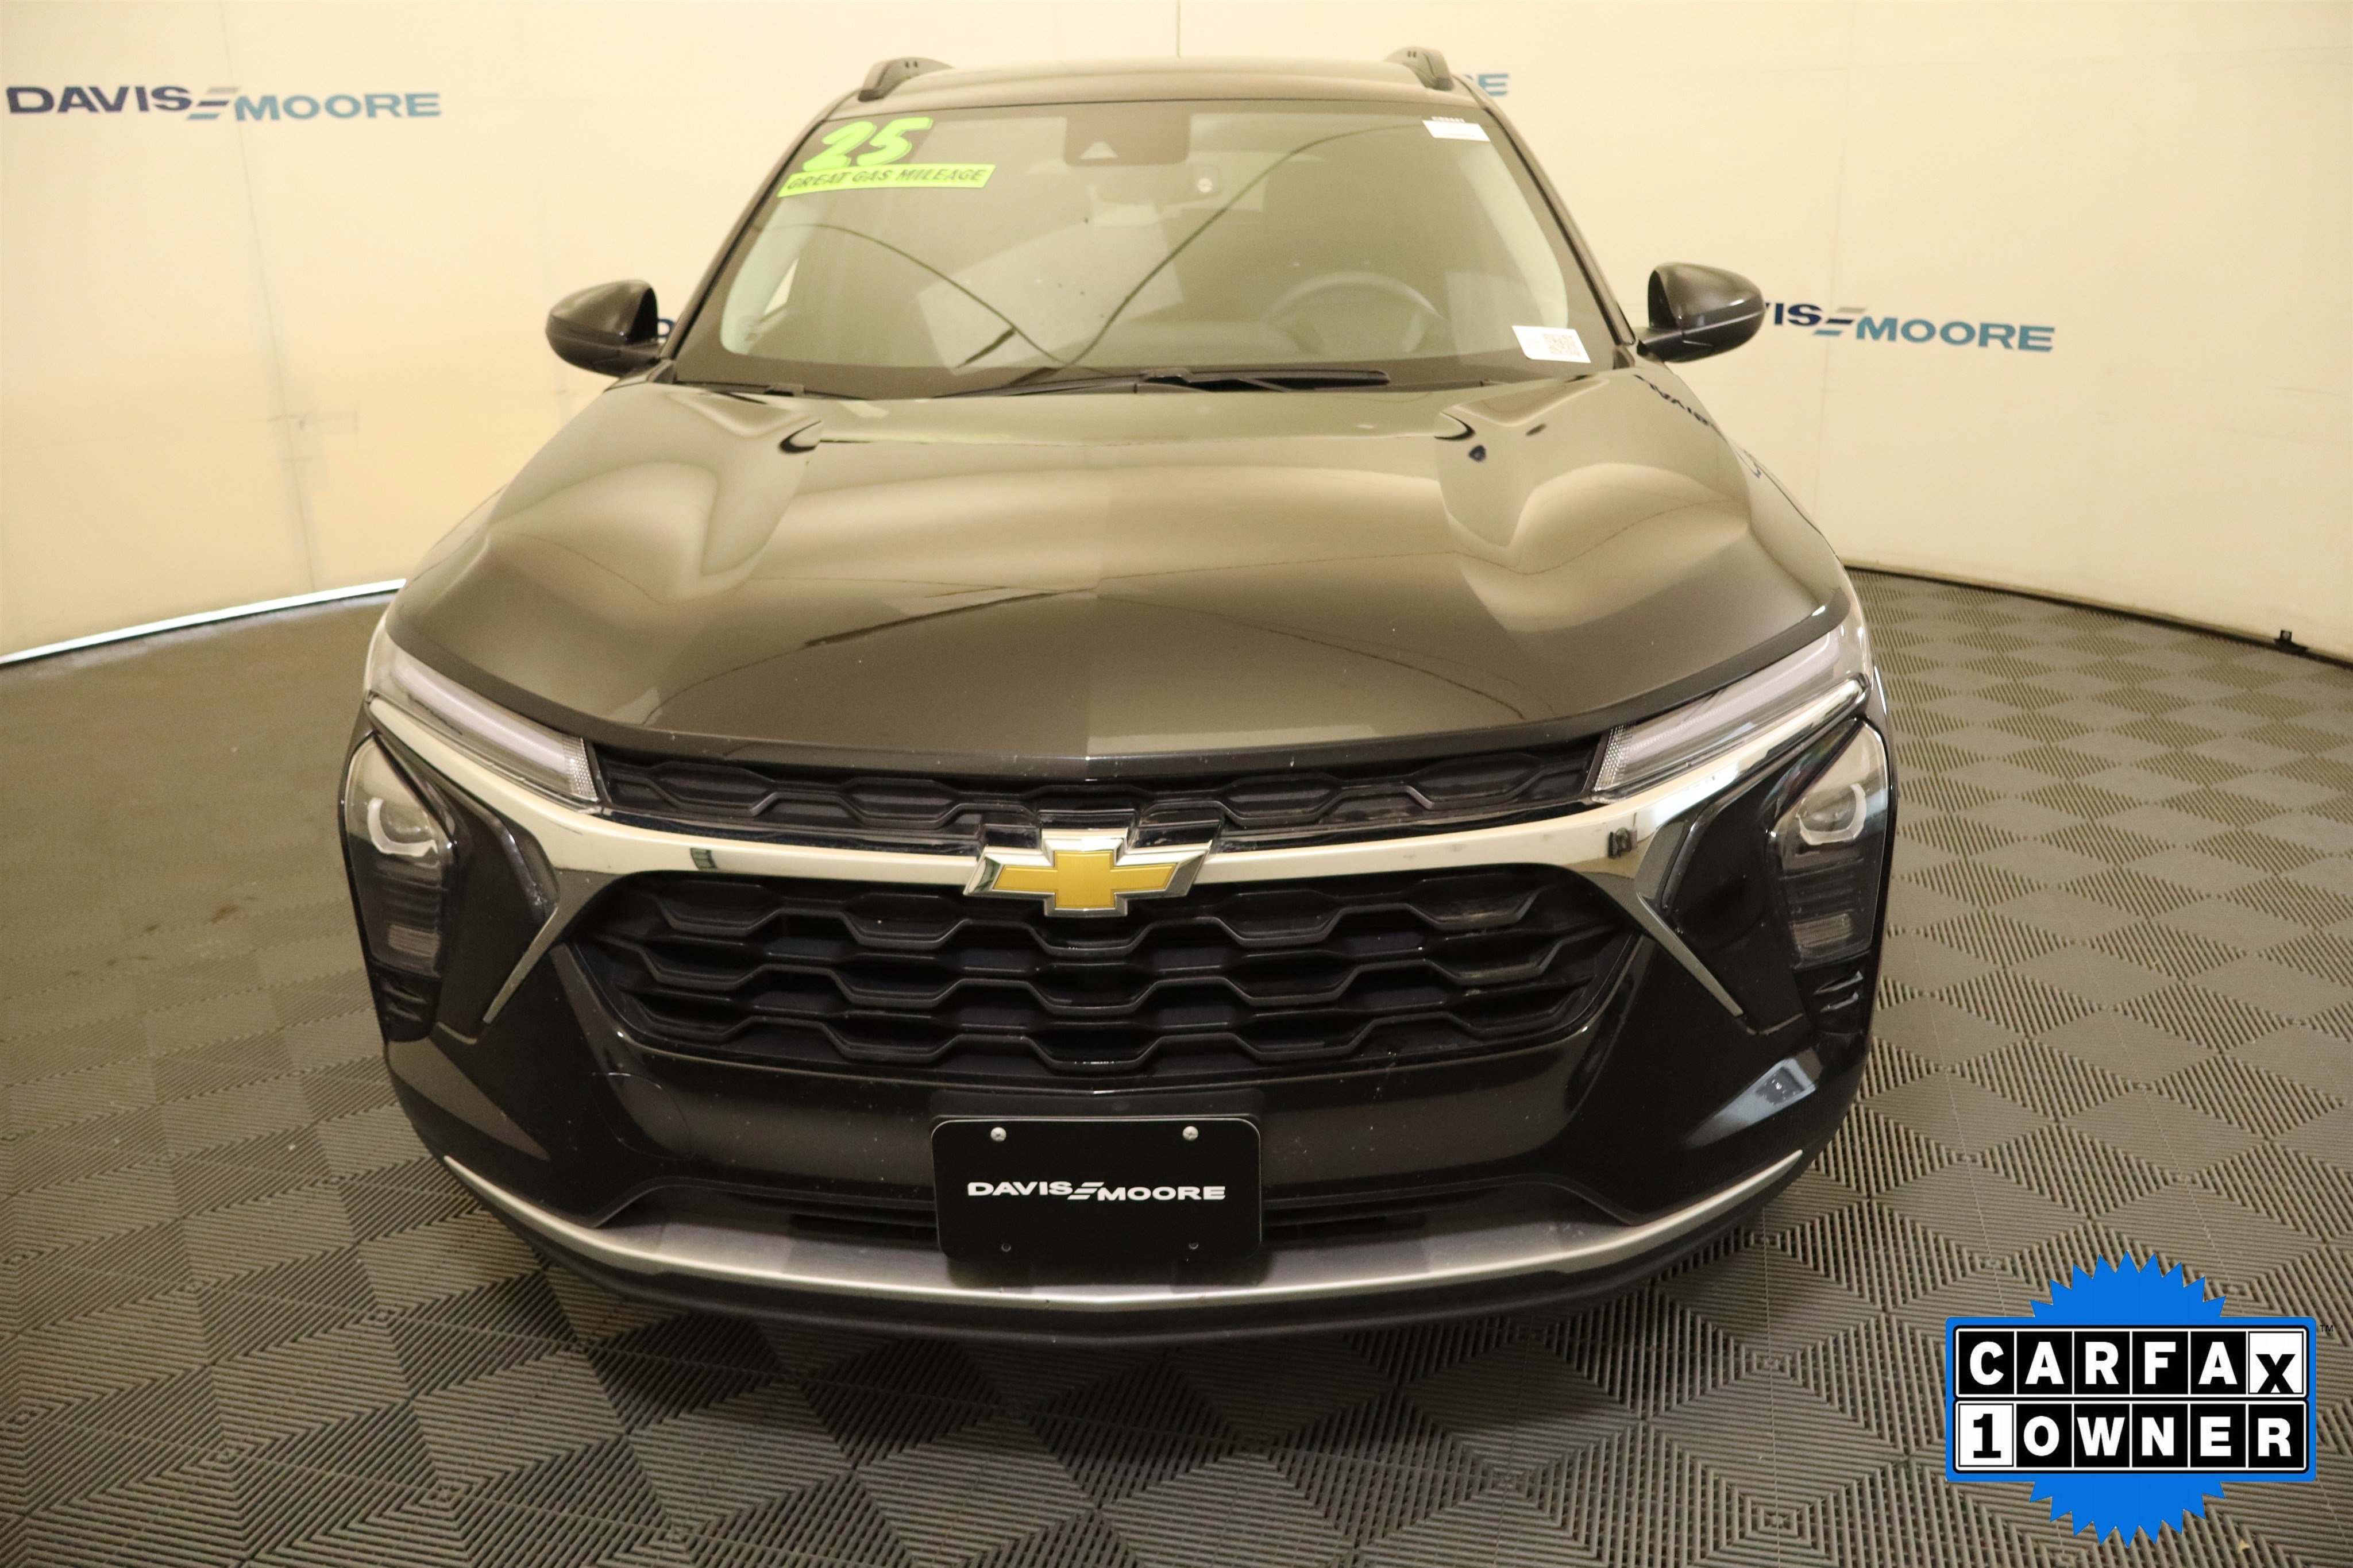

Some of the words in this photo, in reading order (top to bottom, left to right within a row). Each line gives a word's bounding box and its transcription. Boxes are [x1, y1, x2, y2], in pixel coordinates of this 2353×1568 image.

[6, 86, 193, 114] DAVIS
[234, 92, 441, 121] MOORE
[803, 117, 934, 172] 25
[787, 172, 852, 190] GREAT
[852, 169, 893, 183] GAS
[895, 168, 986, 181] MILEAGE
[1856, 316, 2055, 352] MOORE
[967, 1181, 1073, 1196] DAVIS
[1097, 1186, 1226, 1201] MOORE
